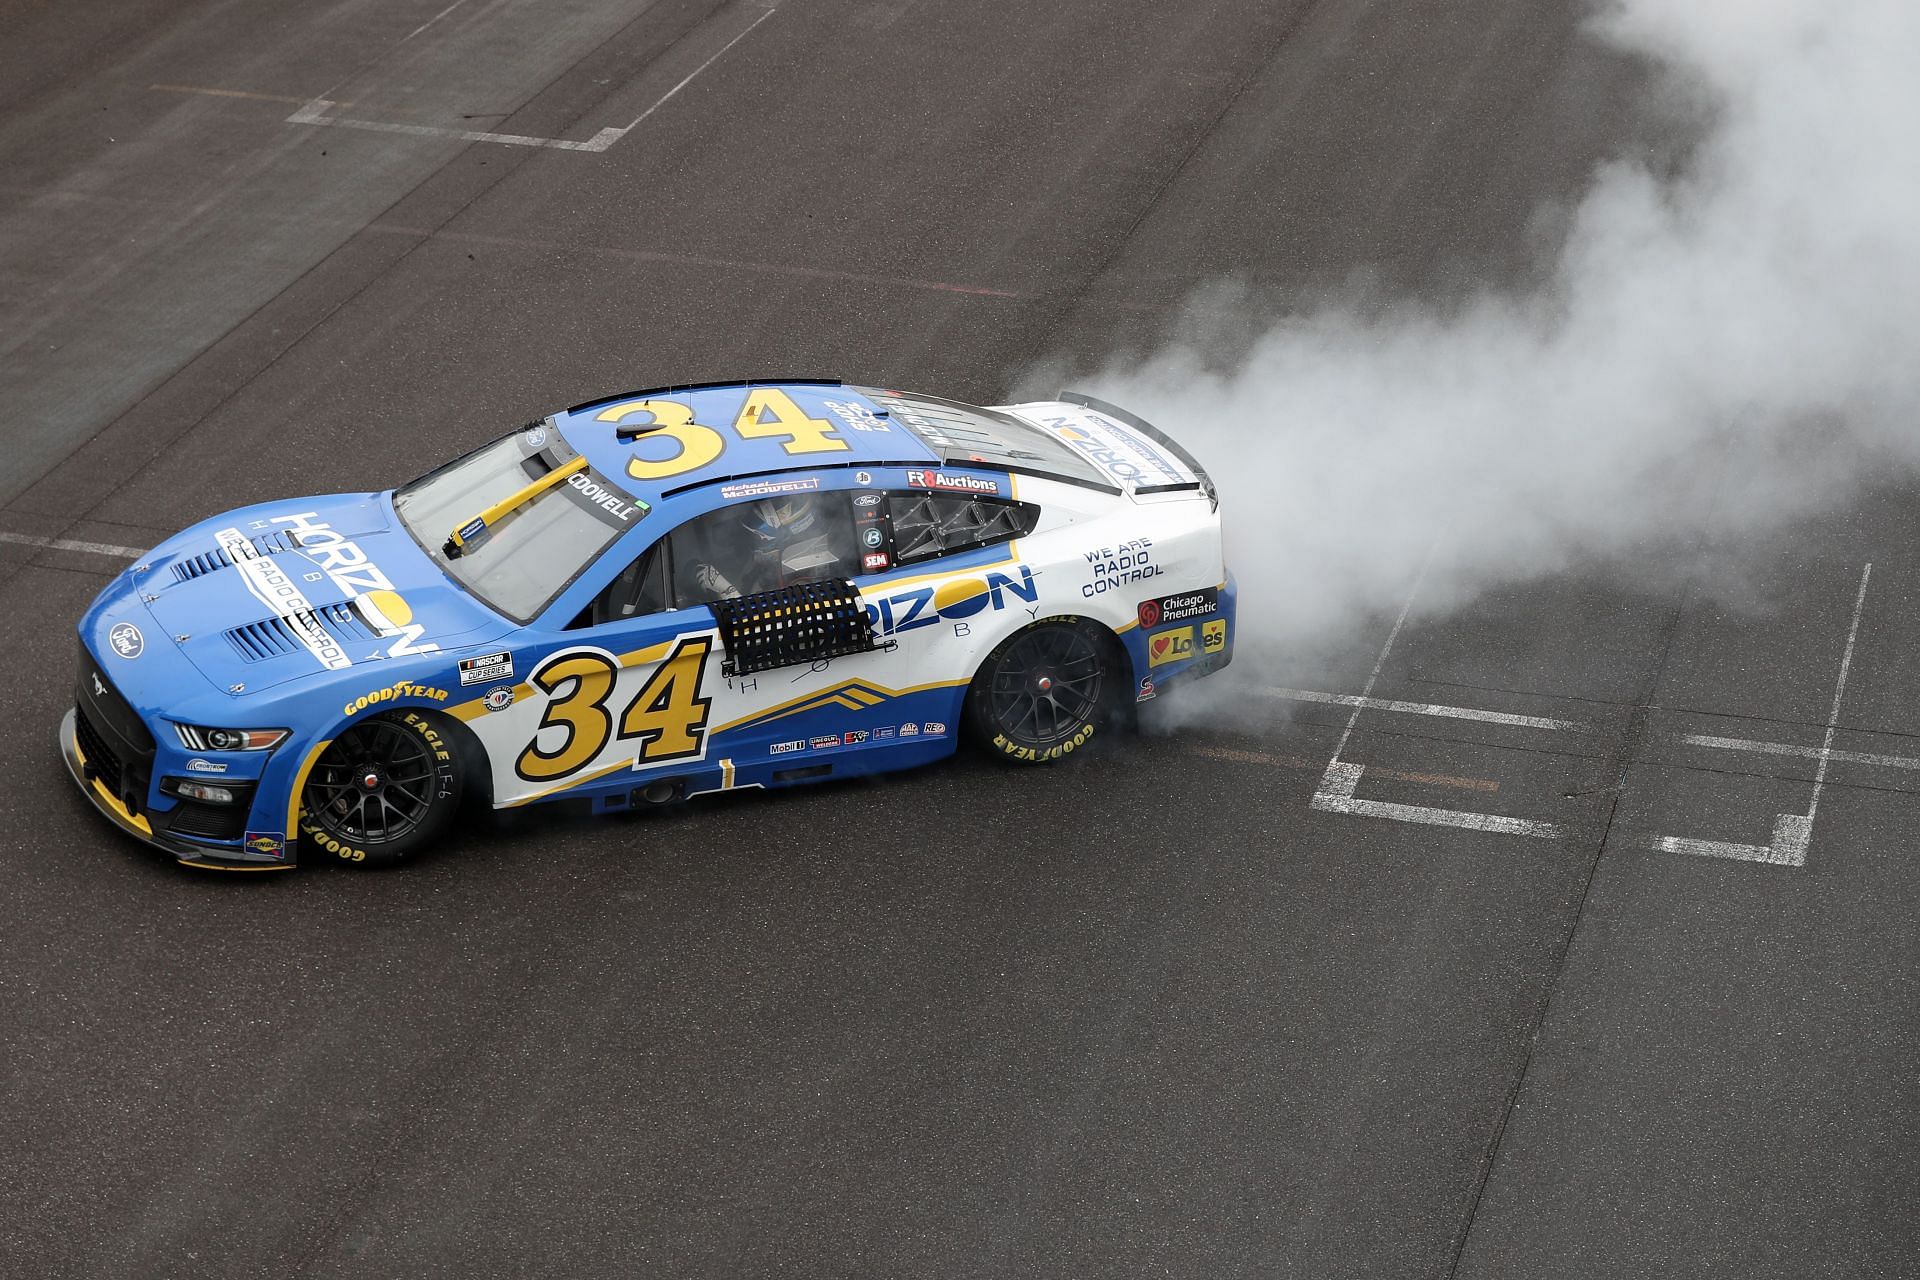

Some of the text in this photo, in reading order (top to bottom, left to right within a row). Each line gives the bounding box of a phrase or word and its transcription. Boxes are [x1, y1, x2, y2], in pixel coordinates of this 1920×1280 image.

[593, 388, 853, 481] 34
[567, 472, 634, 520] CDOWELL
[865, 554, 887, 567] SEM
[1084, 537, 1152, 563] WE ARE
[1094, 551, 1149, 577] RADIO
[270, 511, 443, 658] HORIZON
[1082, 564, 1164, 598] CONTROL
[1163, 595, 1204, 610] Chicago
[1163, 602, 1217, 621] Pneumatic
[111, 625, 140, 656] Ford
[468, 666, 506, 680] CUP SERIES
[477, 655, 504, 668] NASCAR
[344, 681, 448, 716] GOODYEAR
[514, 634, 713, 782] 34
[405, 712, 450, 761] EAGLE
[771, 743, 795, 753] Mobil
[993, 724, 1094, 761] GOODYEAR
[247, 840, 283, 849] SUNOCO
